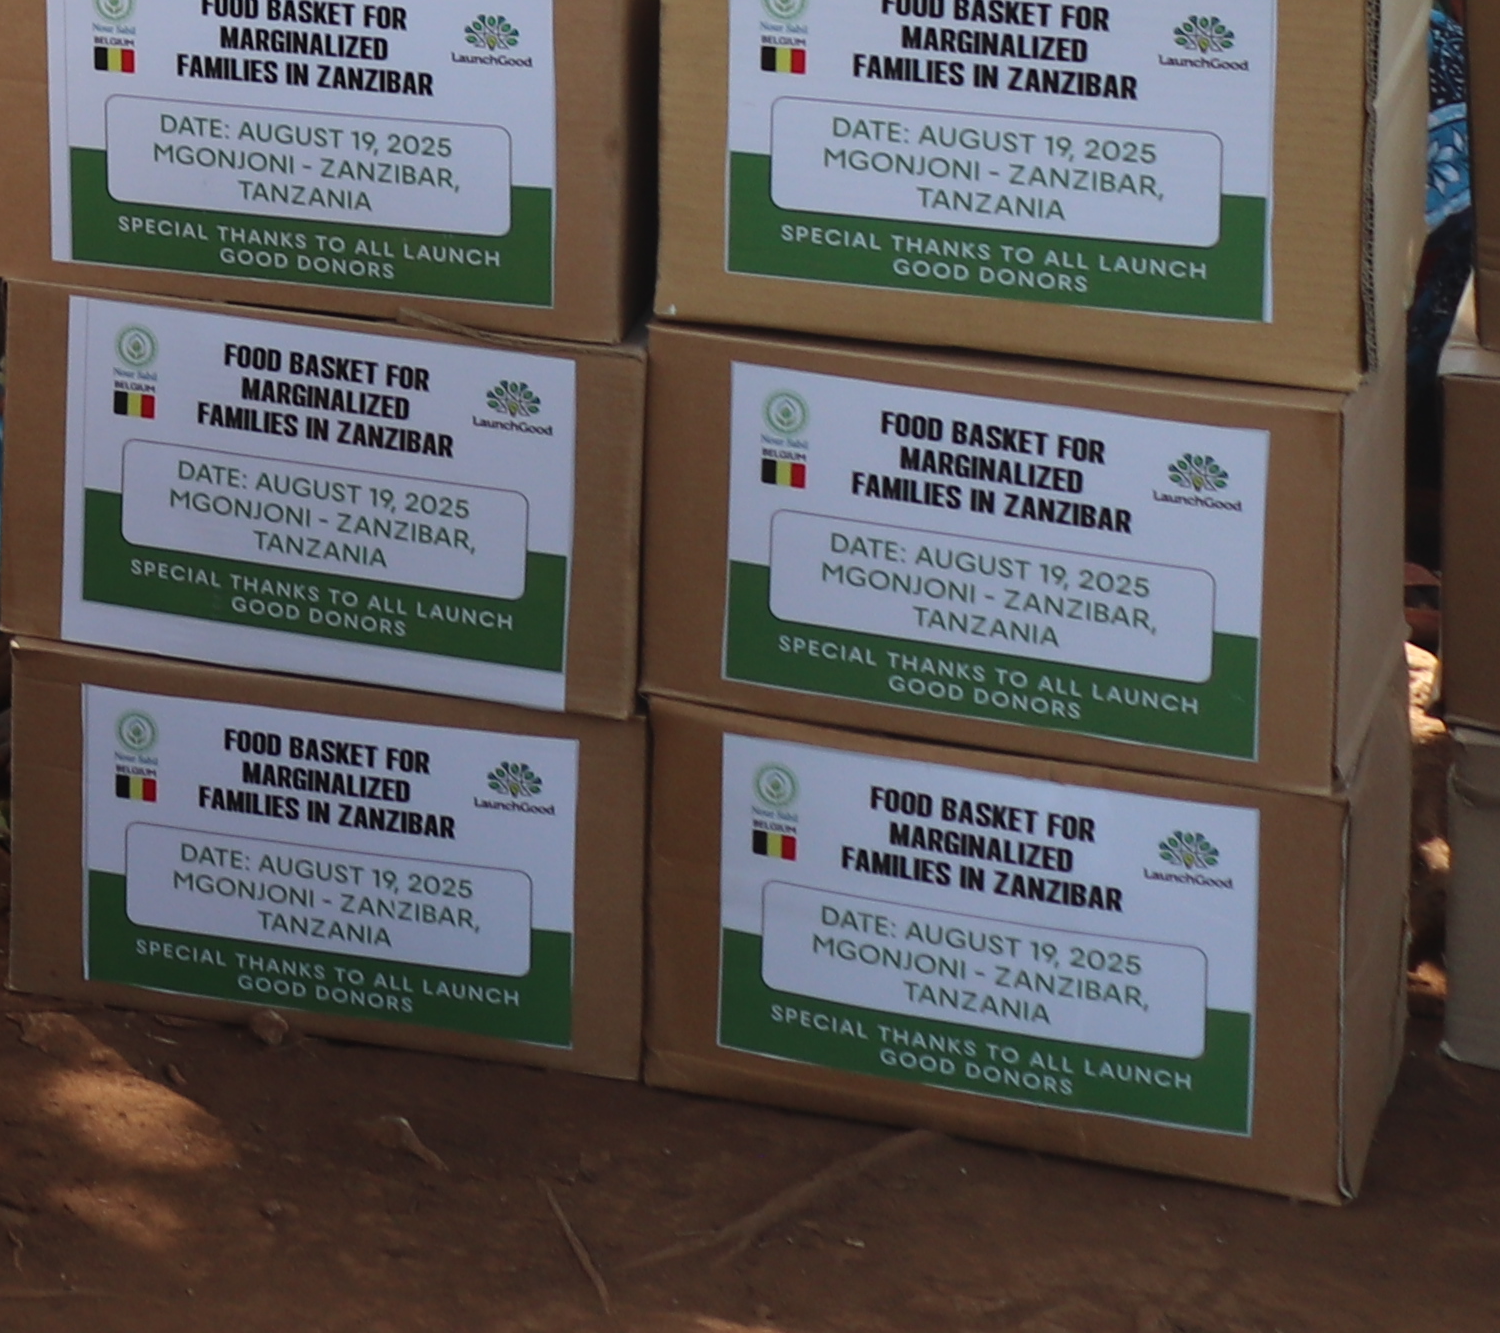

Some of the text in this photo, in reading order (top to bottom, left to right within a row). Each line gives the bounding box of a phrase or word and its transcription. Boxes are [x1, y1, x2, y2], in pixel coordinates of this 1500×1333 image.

[219, 25, 389, 61] MARGINALIZED
[363, 4, 407, 31] FOR
[832, 117, 1157, 165] DATE: AUGUST 19, 2025
[197, 401, 454, 458] FAMILIES IN ZANZIBAR
[821, 561, 976, 605] MGONJONI
[1003, 588, 1158, 635] ZANZIBAR,
[912, 606, 1059, 648] TANZANIA
[136, 939, 520, 1008] SPECIAL THANKS TO ALL LAUNCH
[771, 1005, 1191, 1096] SPECIAL THANKS TO ALL LAUNCH
[880, 1047, 1073, 1098] GOOD DONORS
